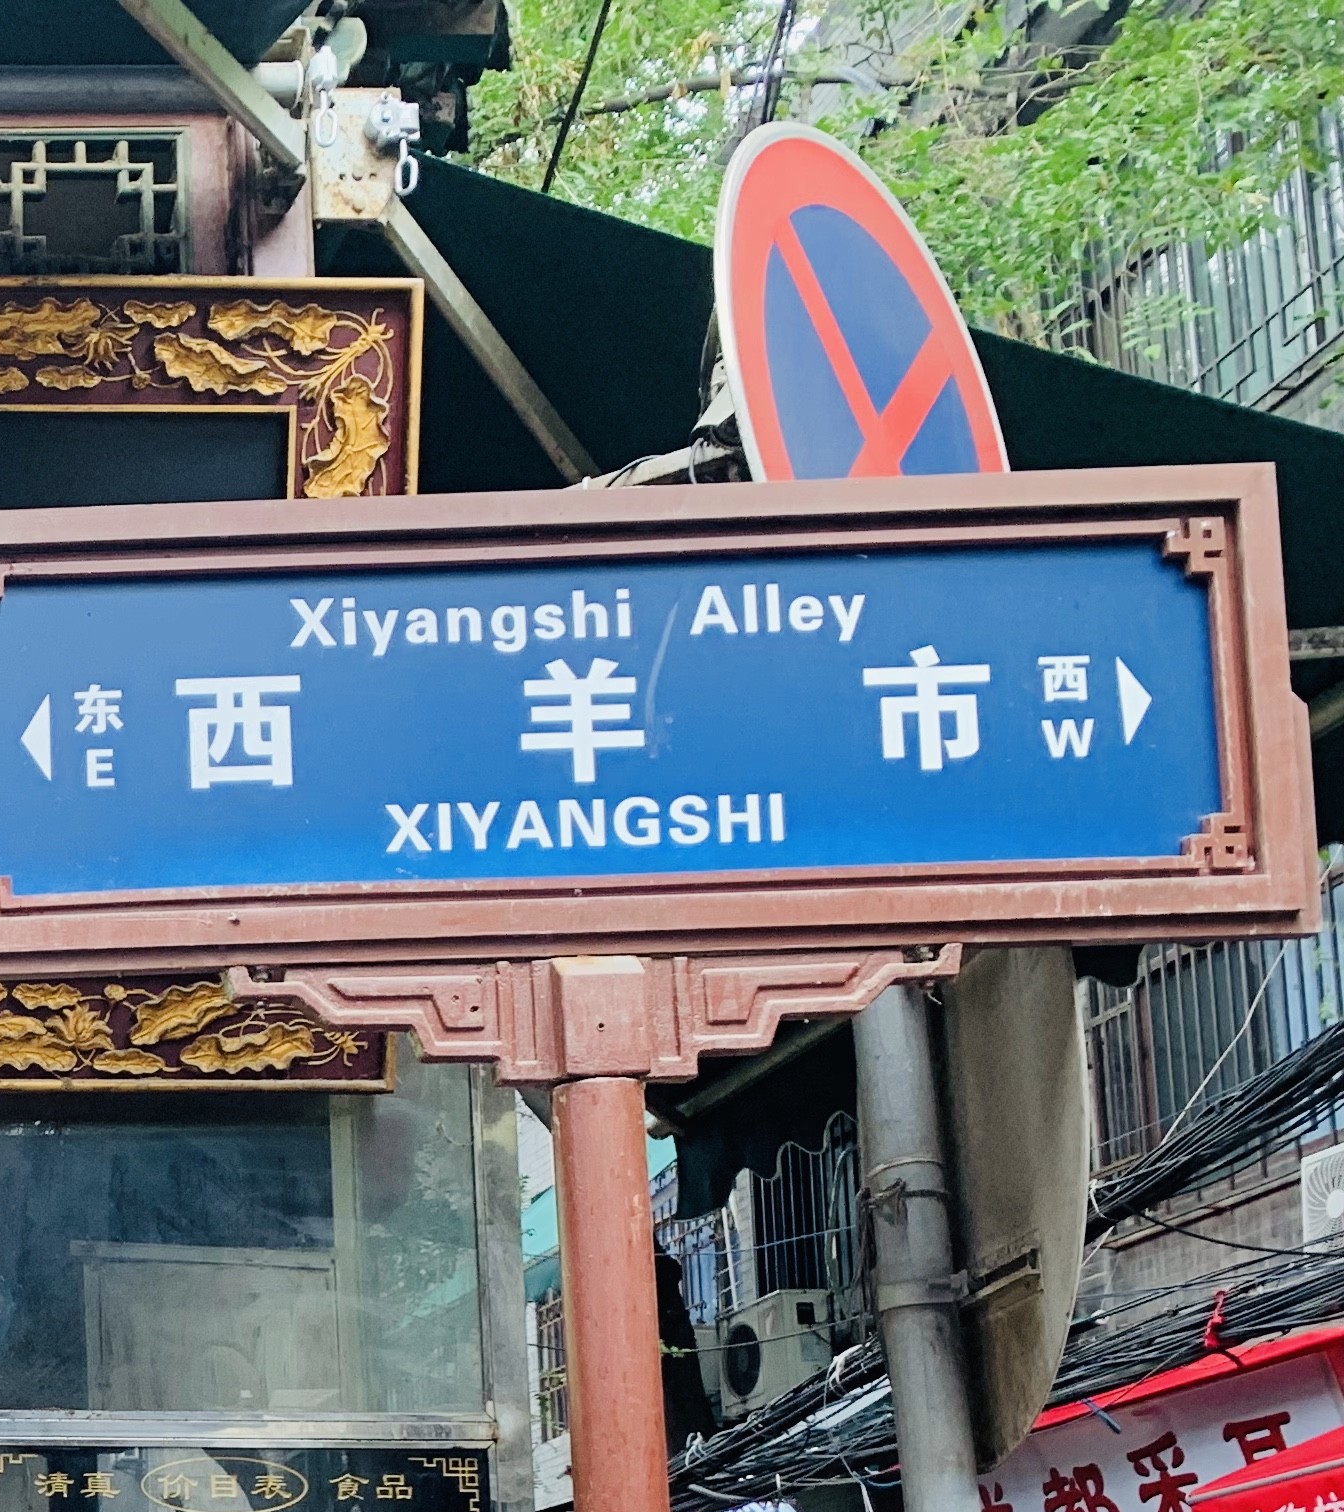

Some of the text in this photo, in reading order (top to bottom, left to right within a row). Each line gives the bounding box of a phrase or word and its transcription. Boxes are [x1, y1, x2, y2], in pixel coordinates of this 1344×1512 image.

[289, 585, 866, 655] Xiyangshi Alley
[1038, 654, 1090, 703] 西
[74, 685, 123, 735] 东
[175, 648, 990, 791] 西羊市
[1043, 719, 1095, 757] W
[88, 749, 113, 787] E
[385, 793, 785, 853] XIYANGSHI
[35, 1473, 412, 1500] 清真 价目表 食品
